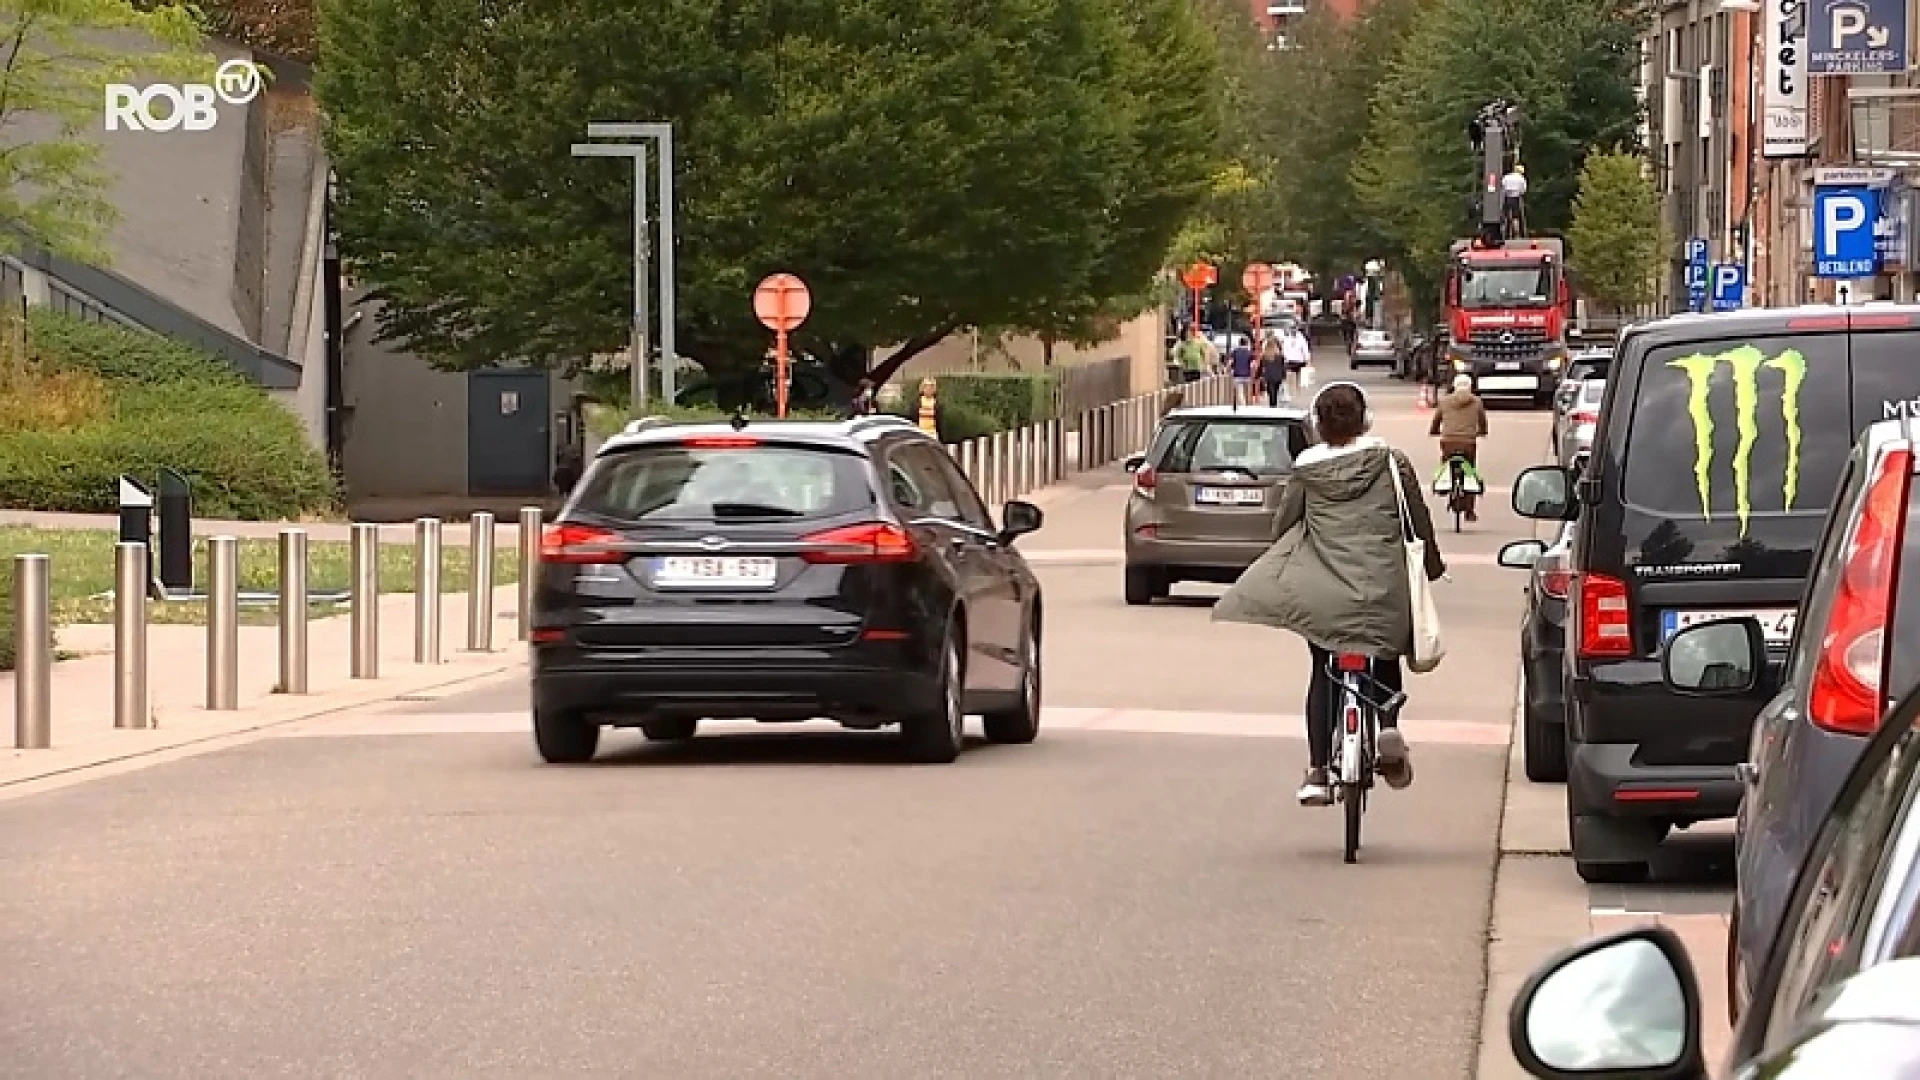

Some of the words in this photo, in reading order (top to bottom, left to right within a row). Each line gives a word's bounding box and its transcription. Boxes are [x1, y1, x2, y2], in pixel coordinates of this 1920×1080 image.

[1833, 9, 1865, 49] P
[1823, 196, 1866, 256] P
[1818, 258, 1873, 275] BETALEND
[1715, 268, 1739, 298] P
[1634, 563, 1742, 577] TRANSPORTER
